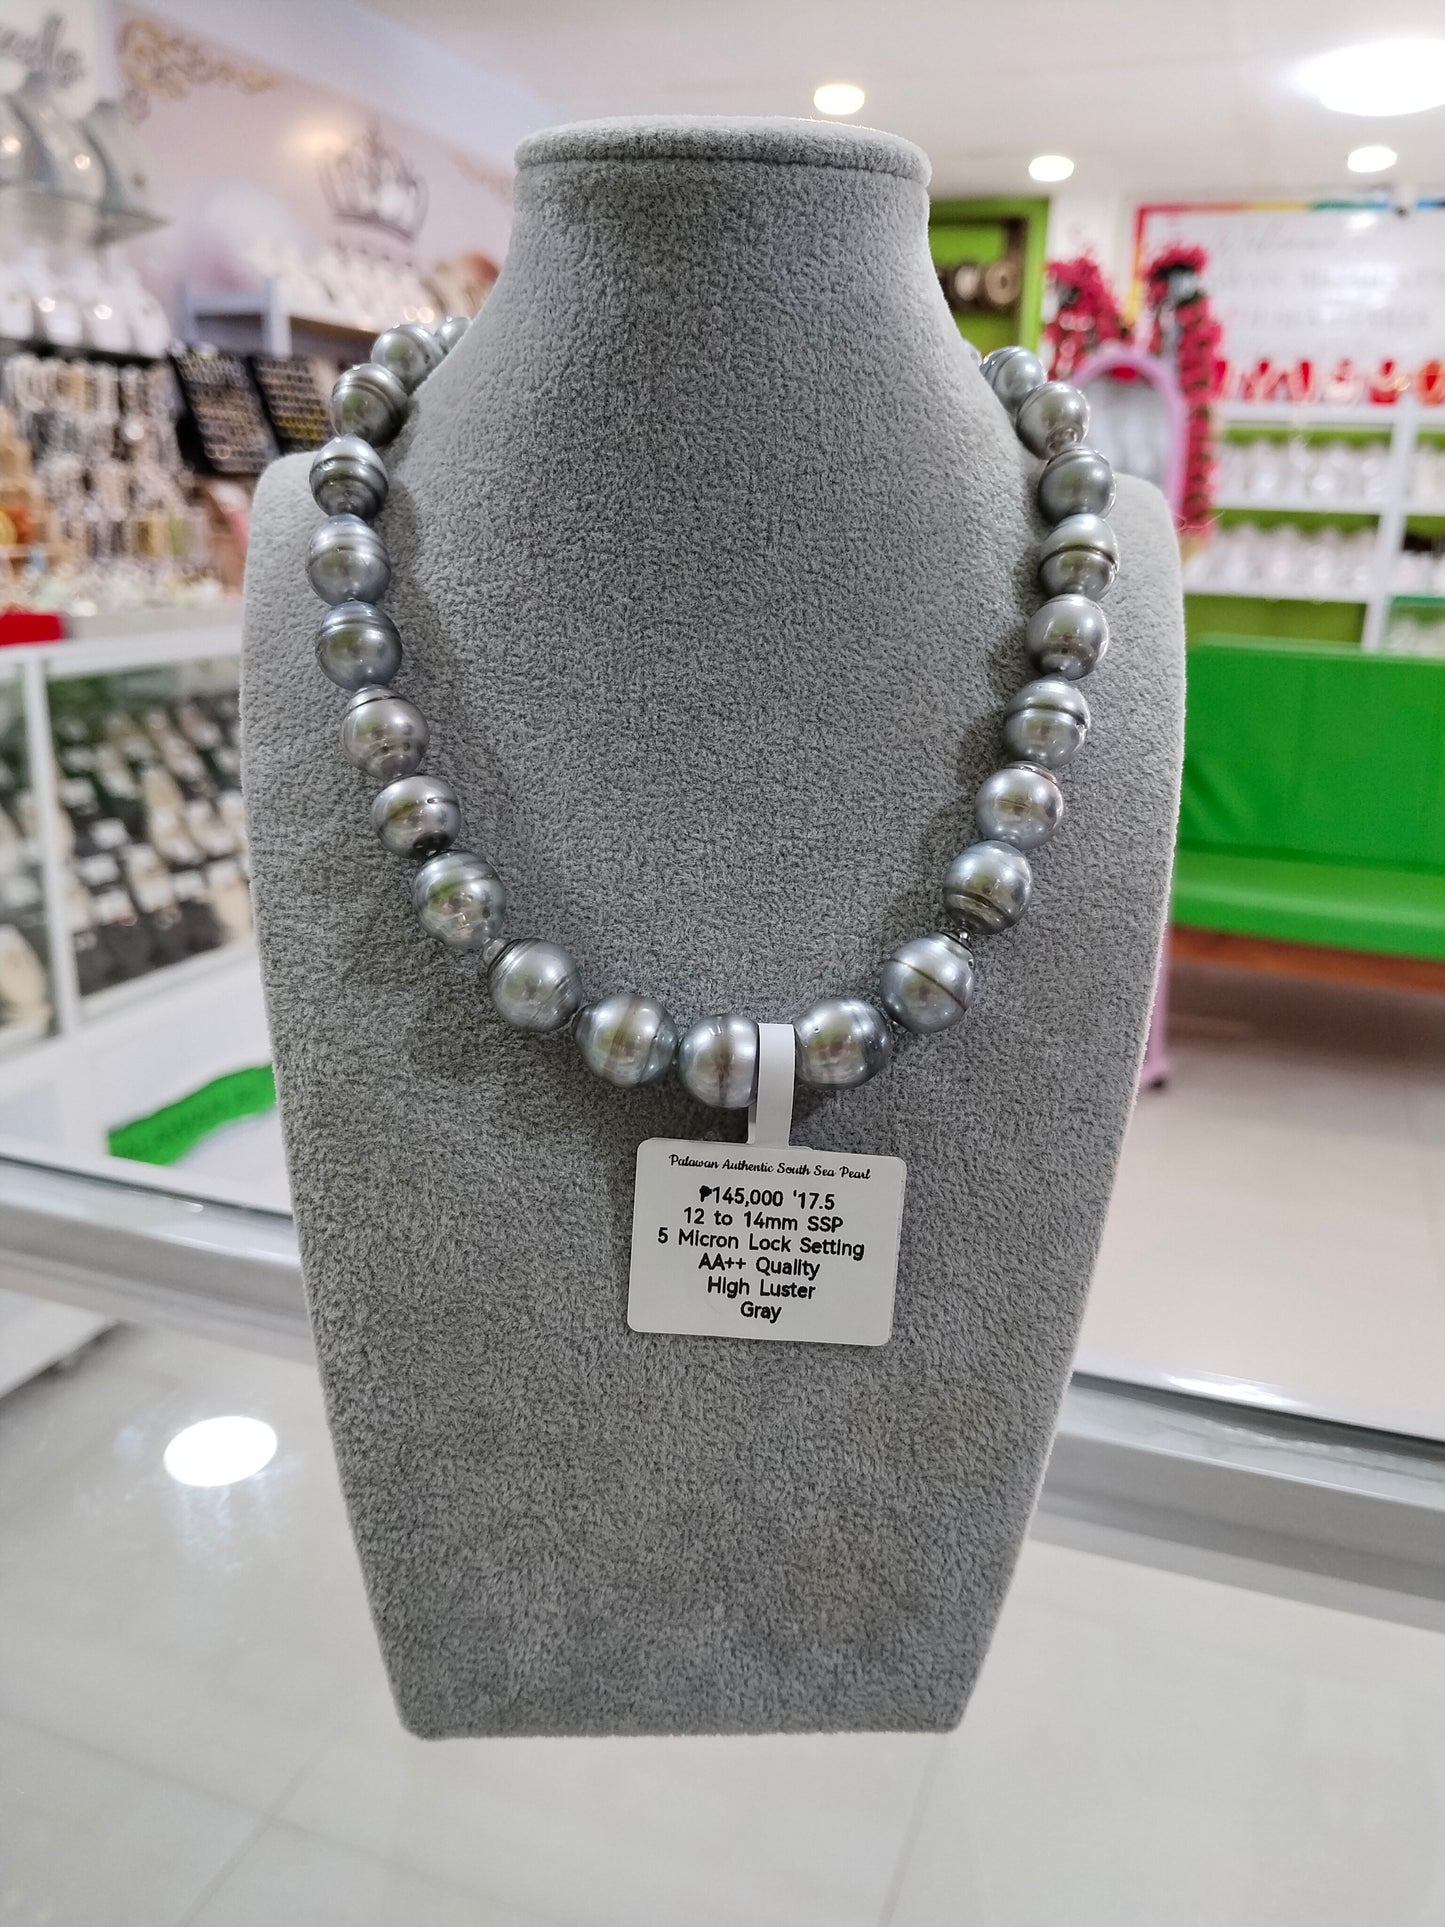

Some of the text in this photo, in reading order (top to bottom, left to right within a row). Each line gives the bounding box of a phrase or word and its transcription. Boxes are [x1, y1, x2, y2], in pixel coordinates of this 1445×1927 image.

[722, 1159, 774, 1172] Authentic
[777, 1163, 811, 1175] South
[814, 1165, 836, 1177] Sea
[839, 1166, 871, 1179] Pearl
[684, 1207, 843, 1233] 12 to 14mm SSP
[658, 1227, 864, 1262] 5 Micron Lock Setting
[698, 1252, 820, 1280] AA++ Quality
[708, 1276, 816, 1299] High Luster
[740, 1301, 782, 1324] Gray
